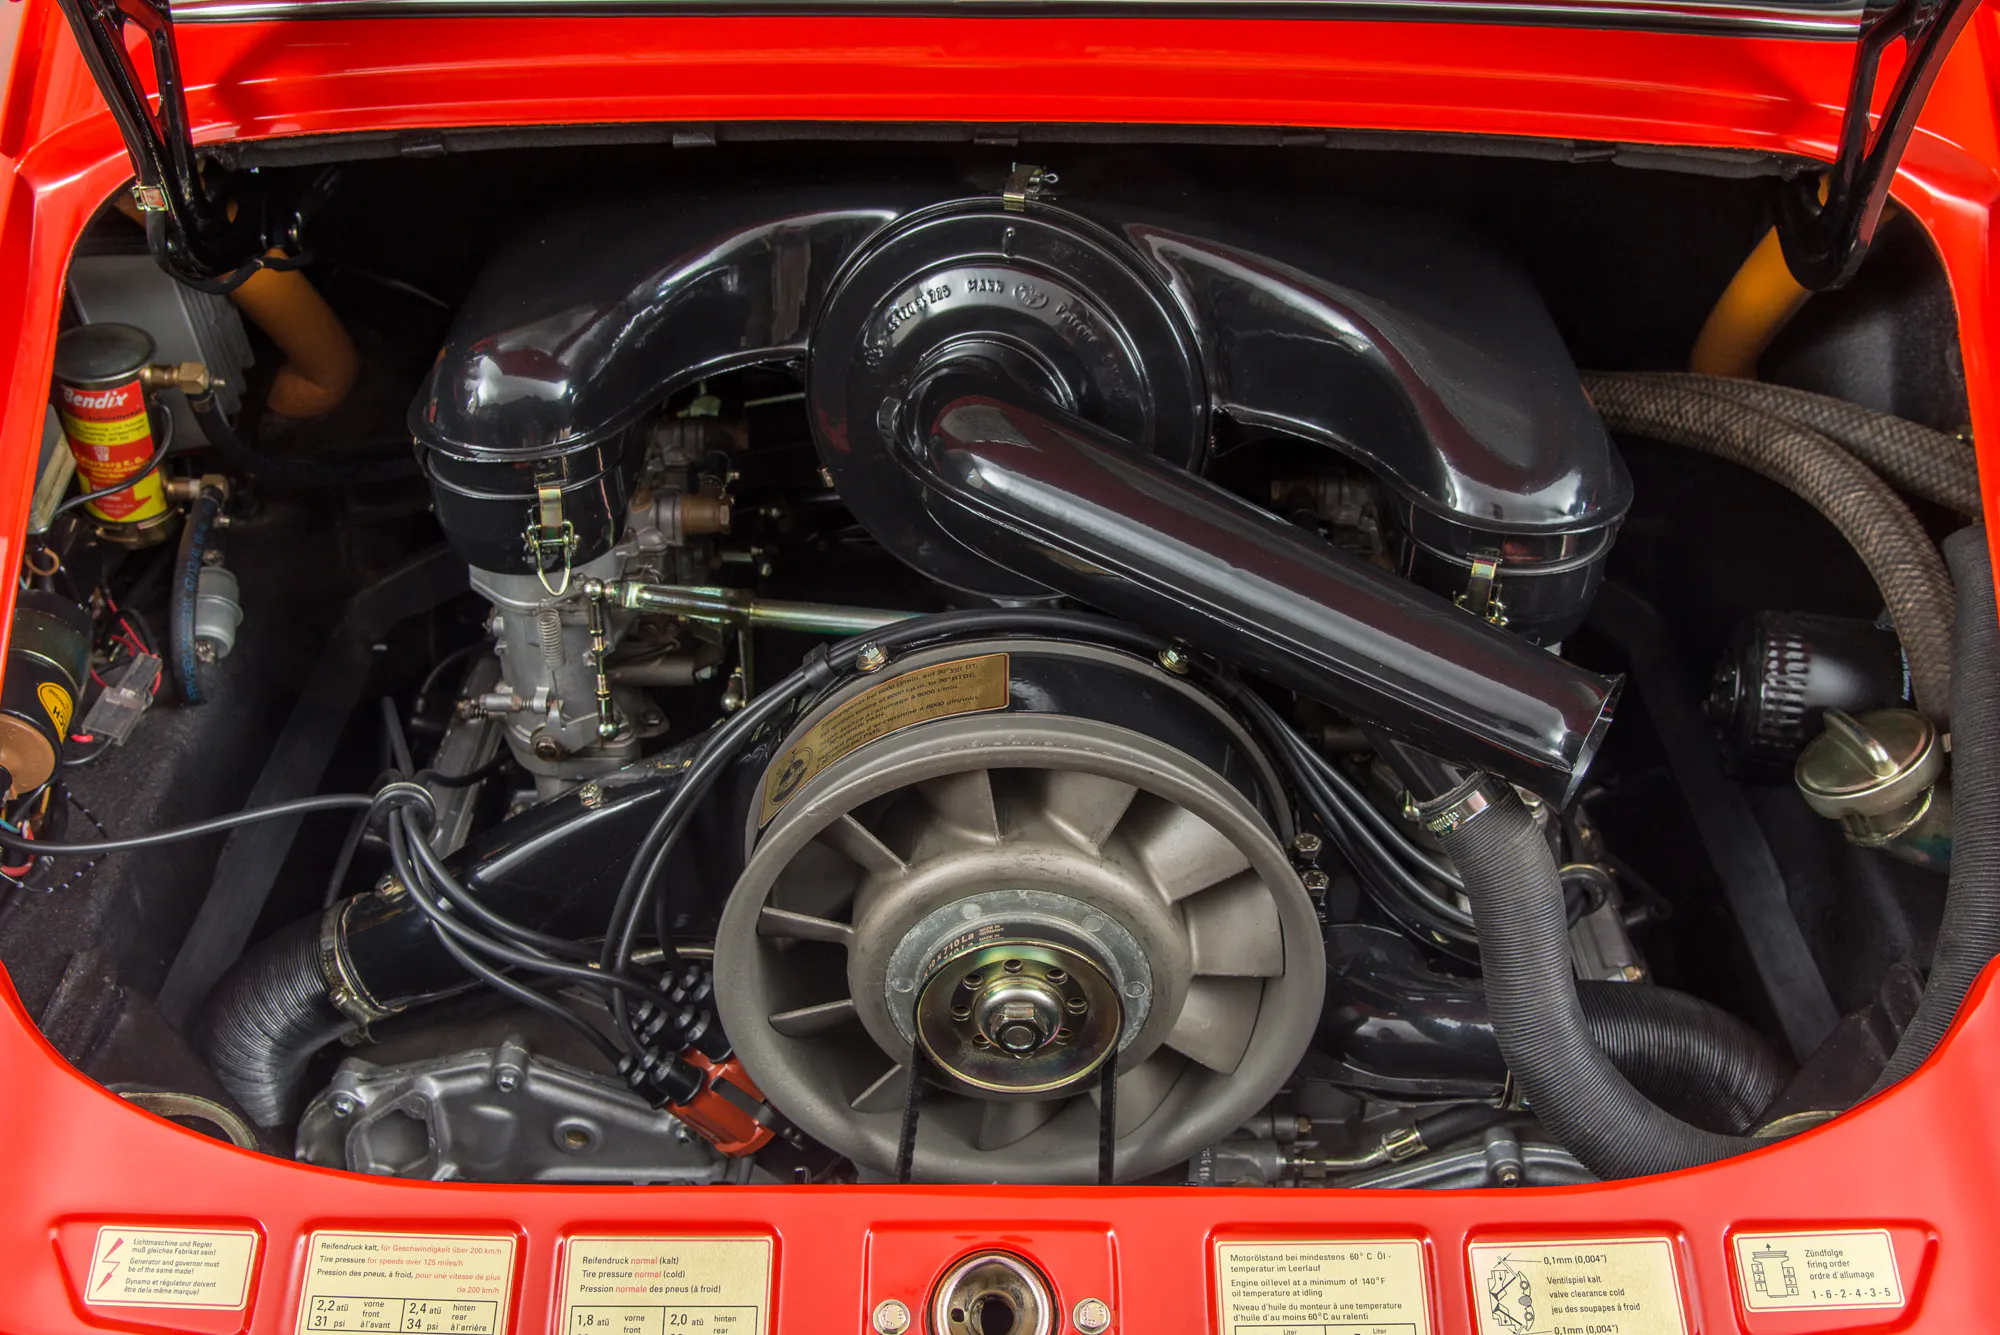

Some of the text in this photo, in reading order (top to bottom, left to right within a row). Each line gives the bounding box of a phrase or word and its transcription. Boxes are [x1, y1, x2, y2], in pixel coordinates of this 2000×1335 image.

[64, 388, 128, 408] Bendix
[943, 938, 960, 954] 710
[962, 933, 974, 942] La
[134, 1238, 178, 1246] Lichtmaschine
[322, 1242, 362, 1250] Reifendruck
[392, 1245, 450, 1254] Geschwindigkeit
[1805, 1250, 1844, 1258] Zündfolge
[582, 1256, 628, 1265] Reifendruck
[660, 1256, 678, 1266] (kalt)
[582, 1270, 596, 1278] Tire
[598, 1272, 632, 1280] pressure
[663, 1270, 686, 1279] (cold)
[1547, 1276, 1586, 1284] Ventilspiel
[1832, 1270, 1874, 1280] d'allumage
[1231, 1280, 1258, 1288] Engine
[580, 1285, 614, 1293] Pression
[665, 1286, 688, 1294] pneus
[690, 1285, 698, 1294] (à
[700, 1285, 720, 1294] froid)
[1302, 1289, 1322, 1298] idling
[1571, 1290, 1607, 1298] clearance
[1610, 1288, 1624, 1296] cold
[316, 1300, 336, 1312] 2,2
[409, 1302, 426, 1315] 2,4
[1356, 1302, 1402, 1310] temperature
[1551, 1306, 1563, 1314] jeu
[1564, 1304, 1578, 1312] des
[1580, 1305, 1615, 1314] soupapes
[314, 1316, 346, 1328] 31 psi
[577, 1314, 610, 1326] 1,8 atü
[670, 1314, 688, 1326] 2,0
[714, 1314, 736, 1322] hinten
[1234, 1314, 1260, 1322] d'huile
[366, 1320, 390, 1328] l'avant
[407, 1318, 438, 1331] 34 psi
[1554, 1327, 1584, 1335] 0,1mm
